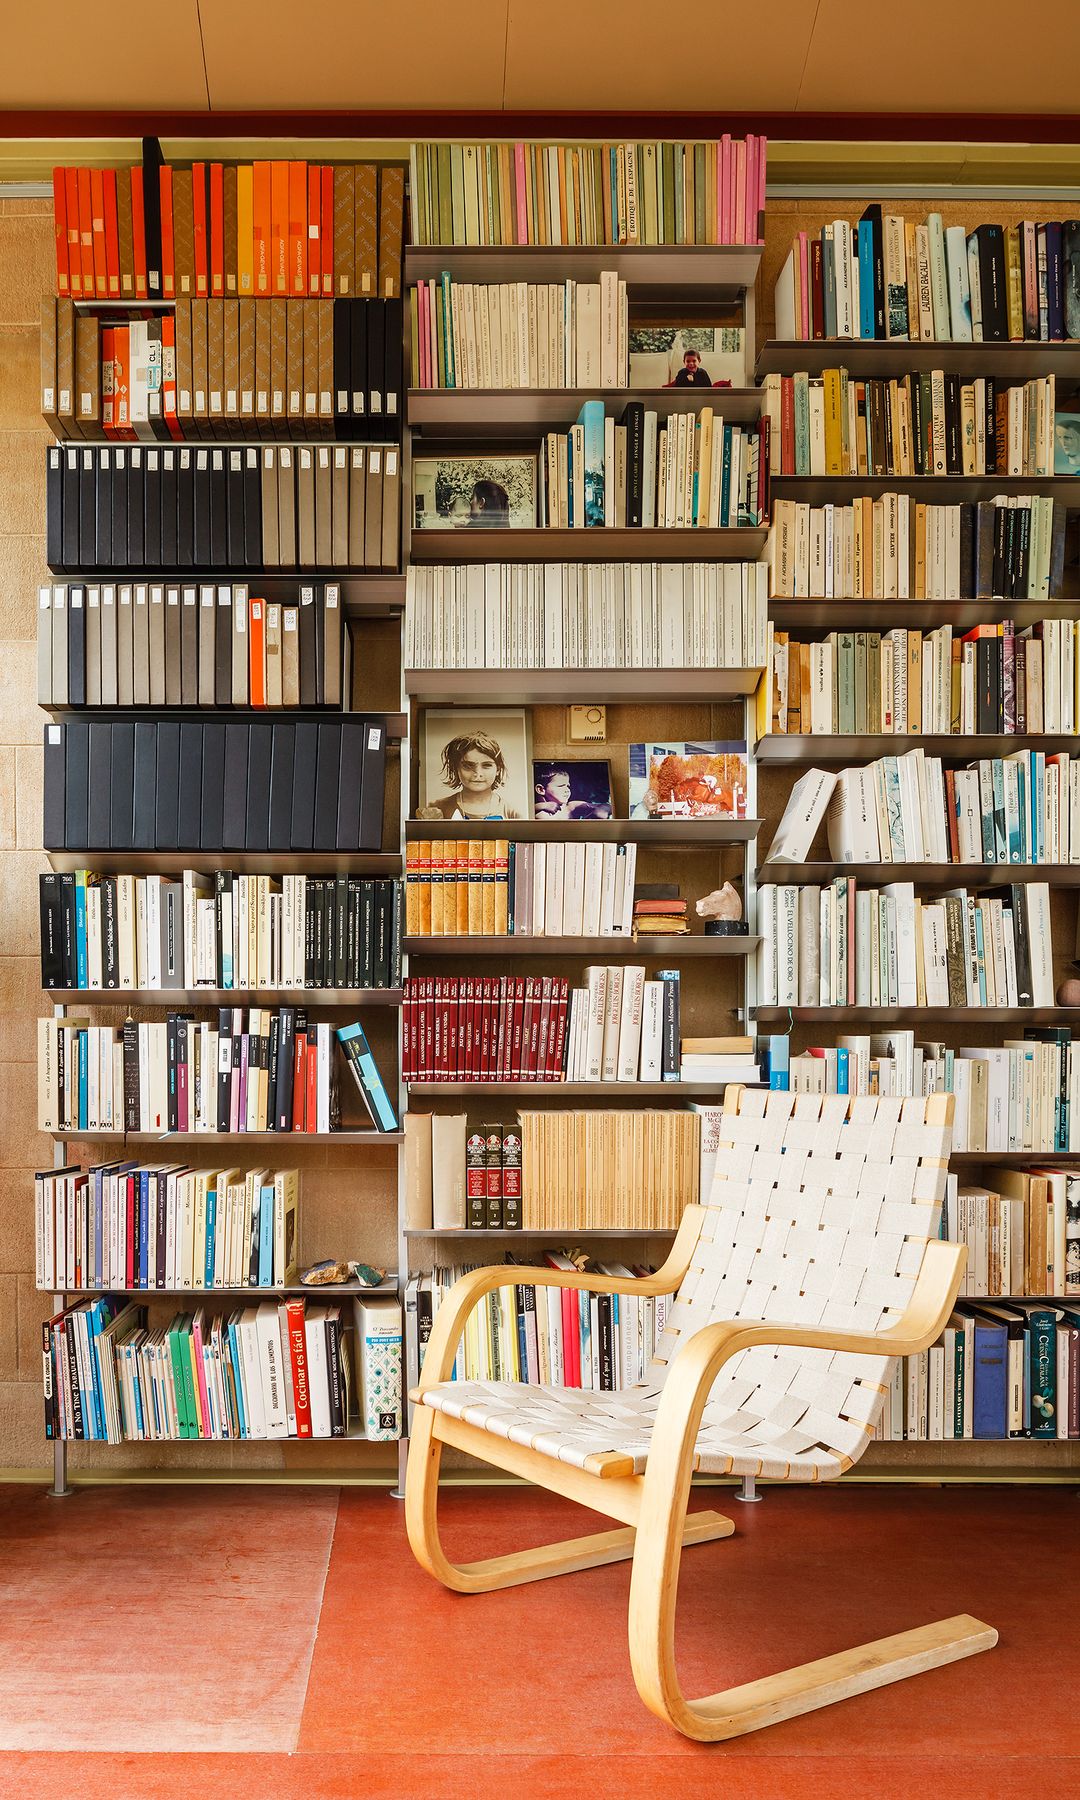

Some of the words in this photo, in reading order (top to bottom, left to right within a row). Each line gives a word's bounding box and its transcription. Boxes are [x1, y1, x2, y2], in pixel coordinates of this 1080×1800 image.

[921, 285, 930, 312] LAUREN
[291, 1330, 303, 1353] fácil
[297, 1354, 304, 1365] es
[296, 1368, 307, 1409] Cocinar
